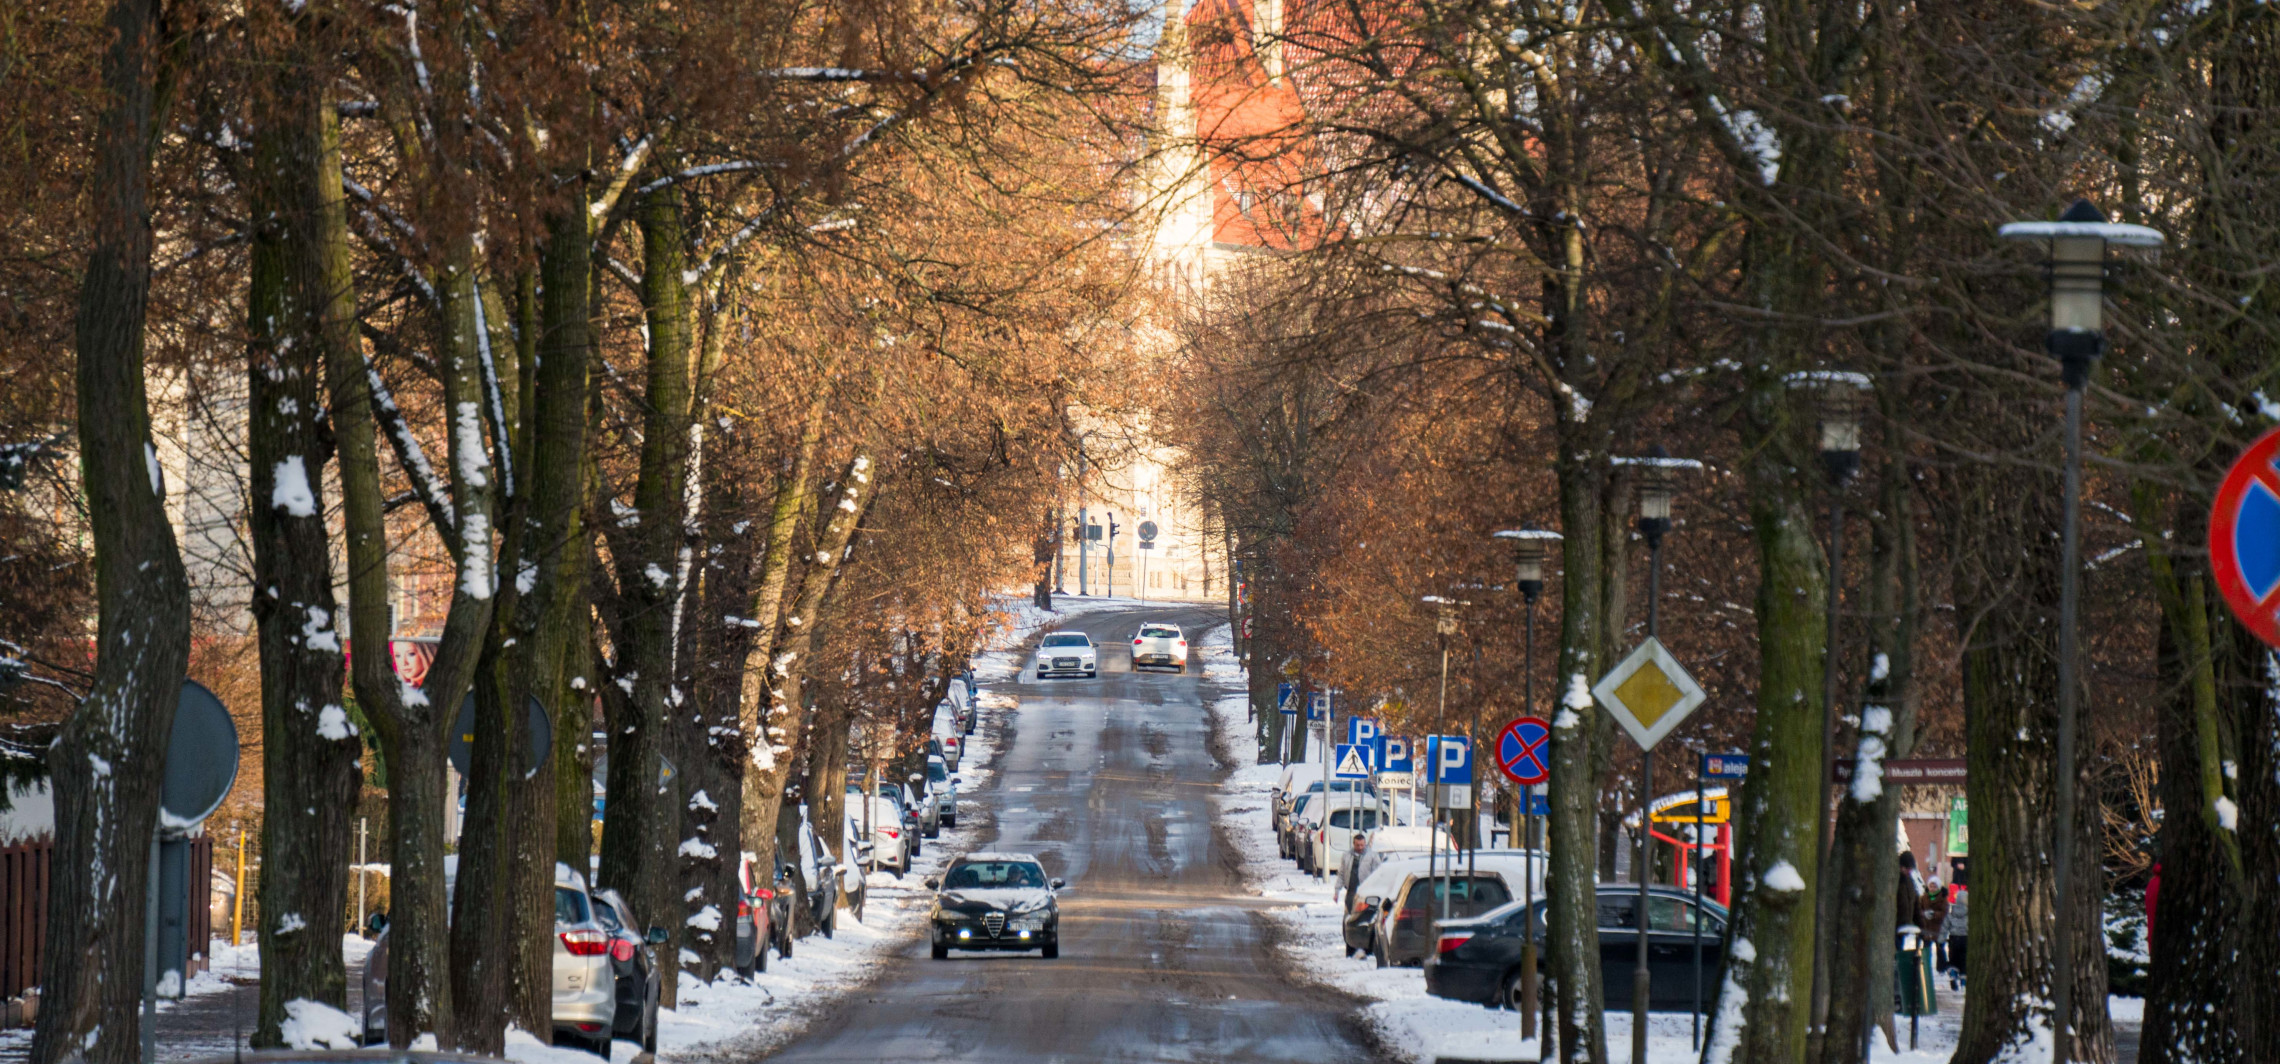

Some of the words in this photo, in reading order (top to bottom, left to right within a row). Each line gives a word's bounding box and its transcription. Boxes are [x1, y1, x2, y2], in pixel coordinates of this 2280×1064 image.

[1356, 719, 1374, 744] P
[1385, 739, 1407, 768] P
[1440, 741, 1465, 778] P
[1378, 775, 1411, 785] Koniec
[1724, 762, 1749, 777] aleja
